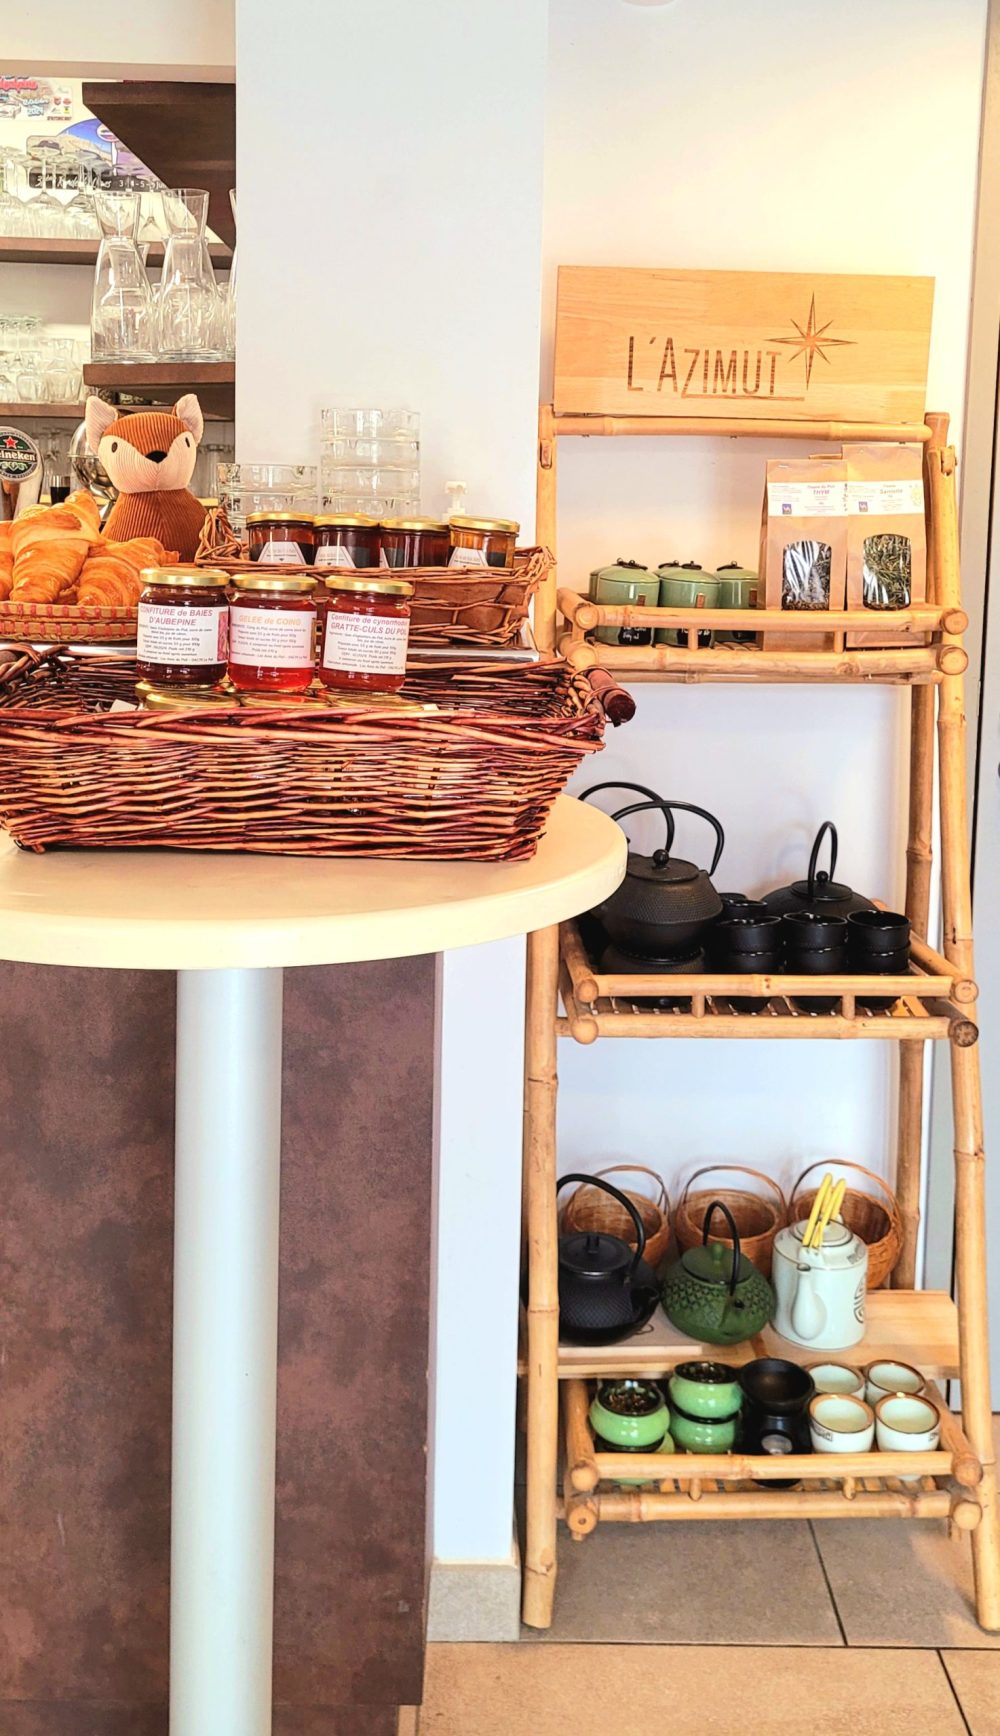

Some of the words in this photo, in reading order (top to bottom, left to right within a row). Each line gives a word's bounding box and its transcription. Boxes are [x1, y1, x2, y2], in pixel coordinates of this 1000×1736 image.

[0, 450, 35, 461] ineken
[177, 608, 187, 616] de
[189, 609, 213, 617] BAIES
[264, 617, 275, 625] de
[362, 616, 372, 624] de
[330, 622, 384, 634] GRATTE-CULS
[385, 627, 396, 635] DU
